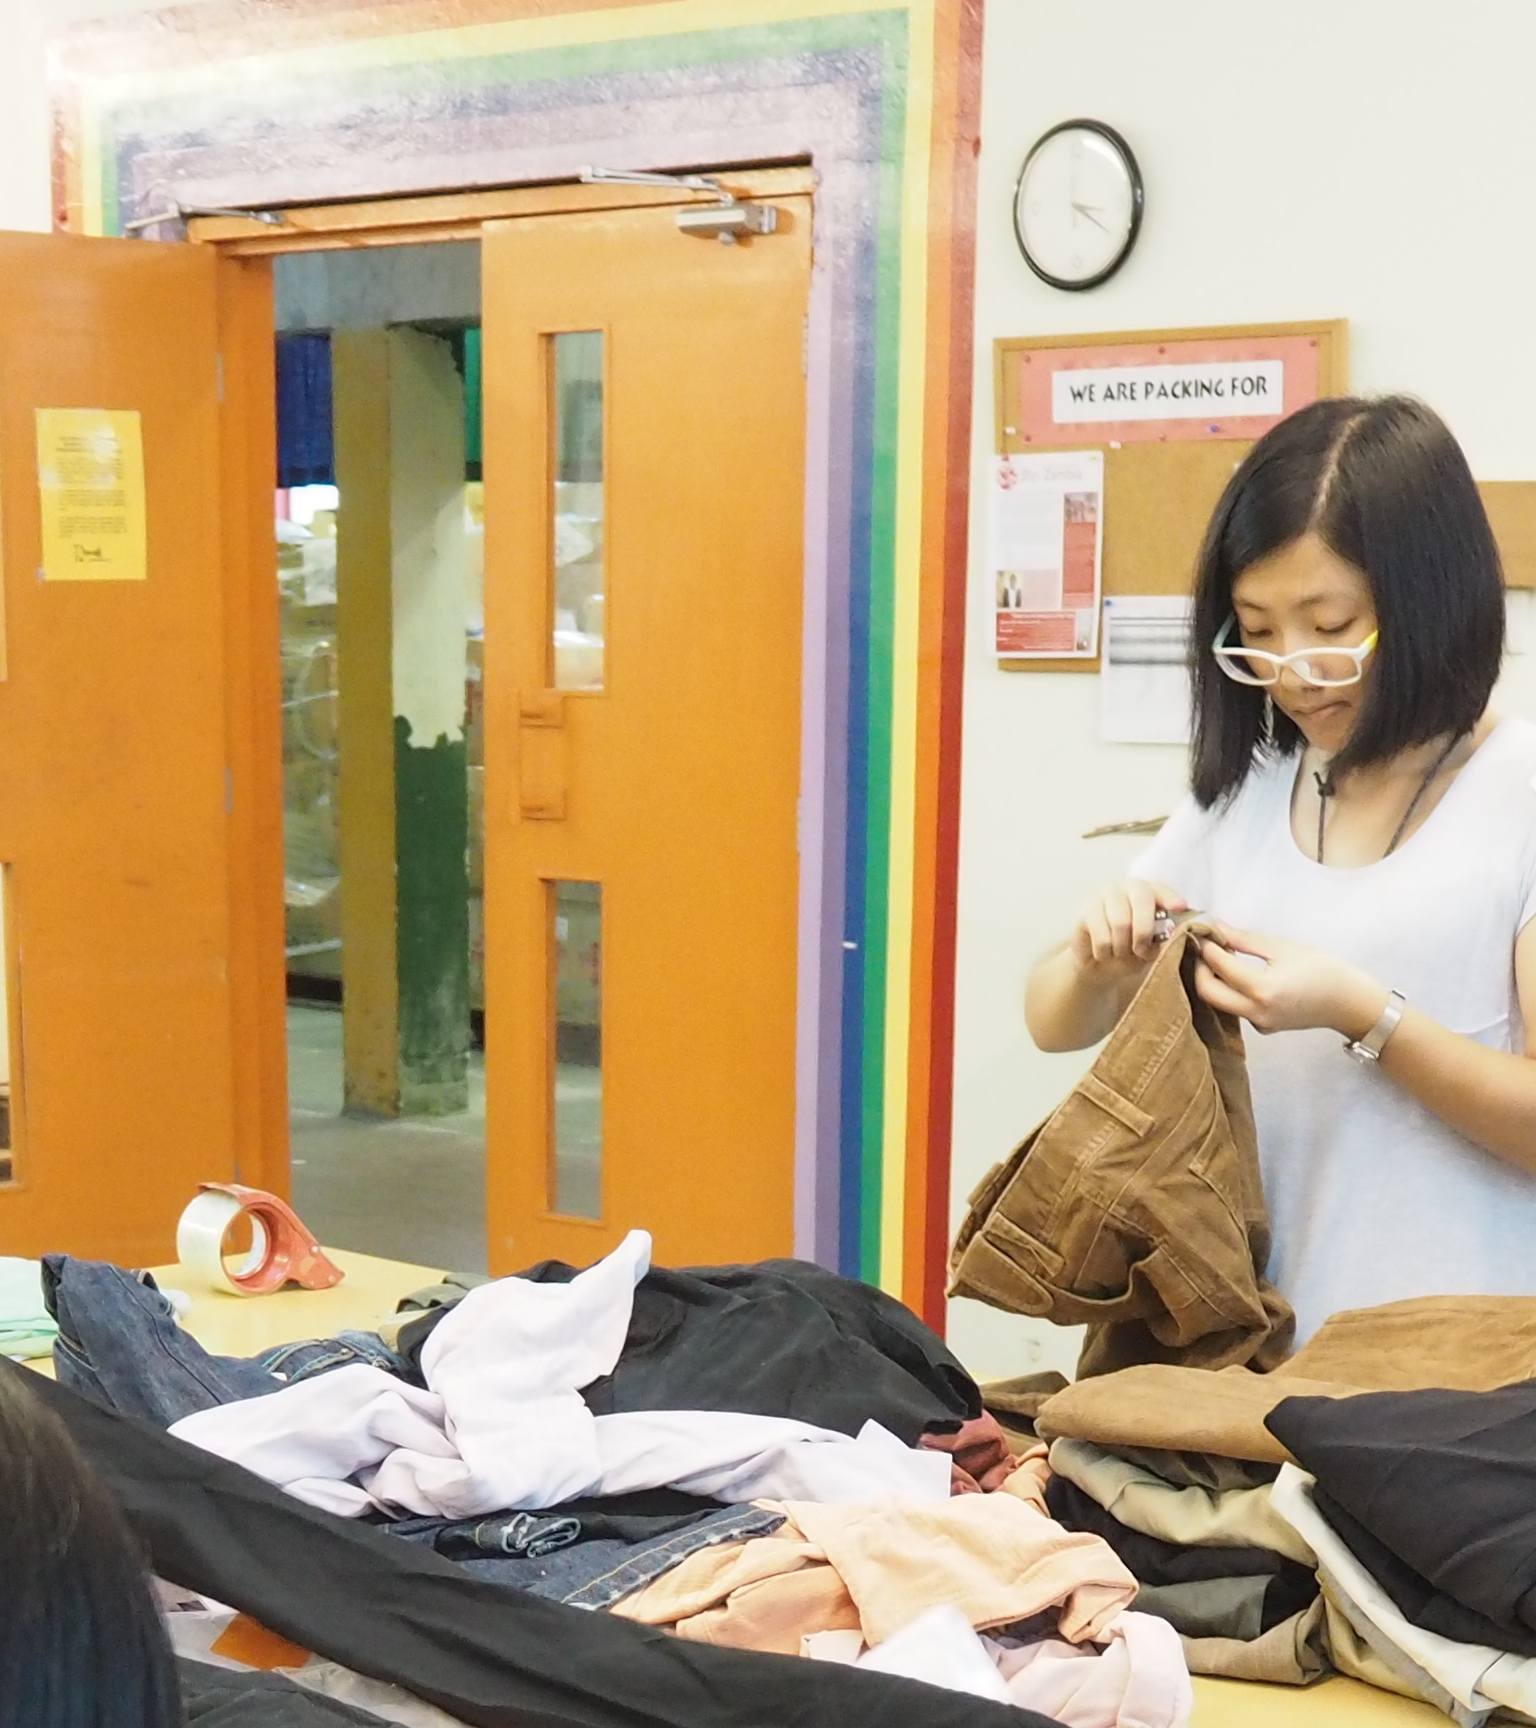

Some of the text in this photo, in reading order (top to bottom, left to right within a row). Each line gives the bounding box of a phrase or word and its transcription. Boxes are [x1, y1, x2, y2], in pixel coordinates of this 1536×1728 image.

[1070, 375, 1268, 403] WE ARE PACKING FOR
